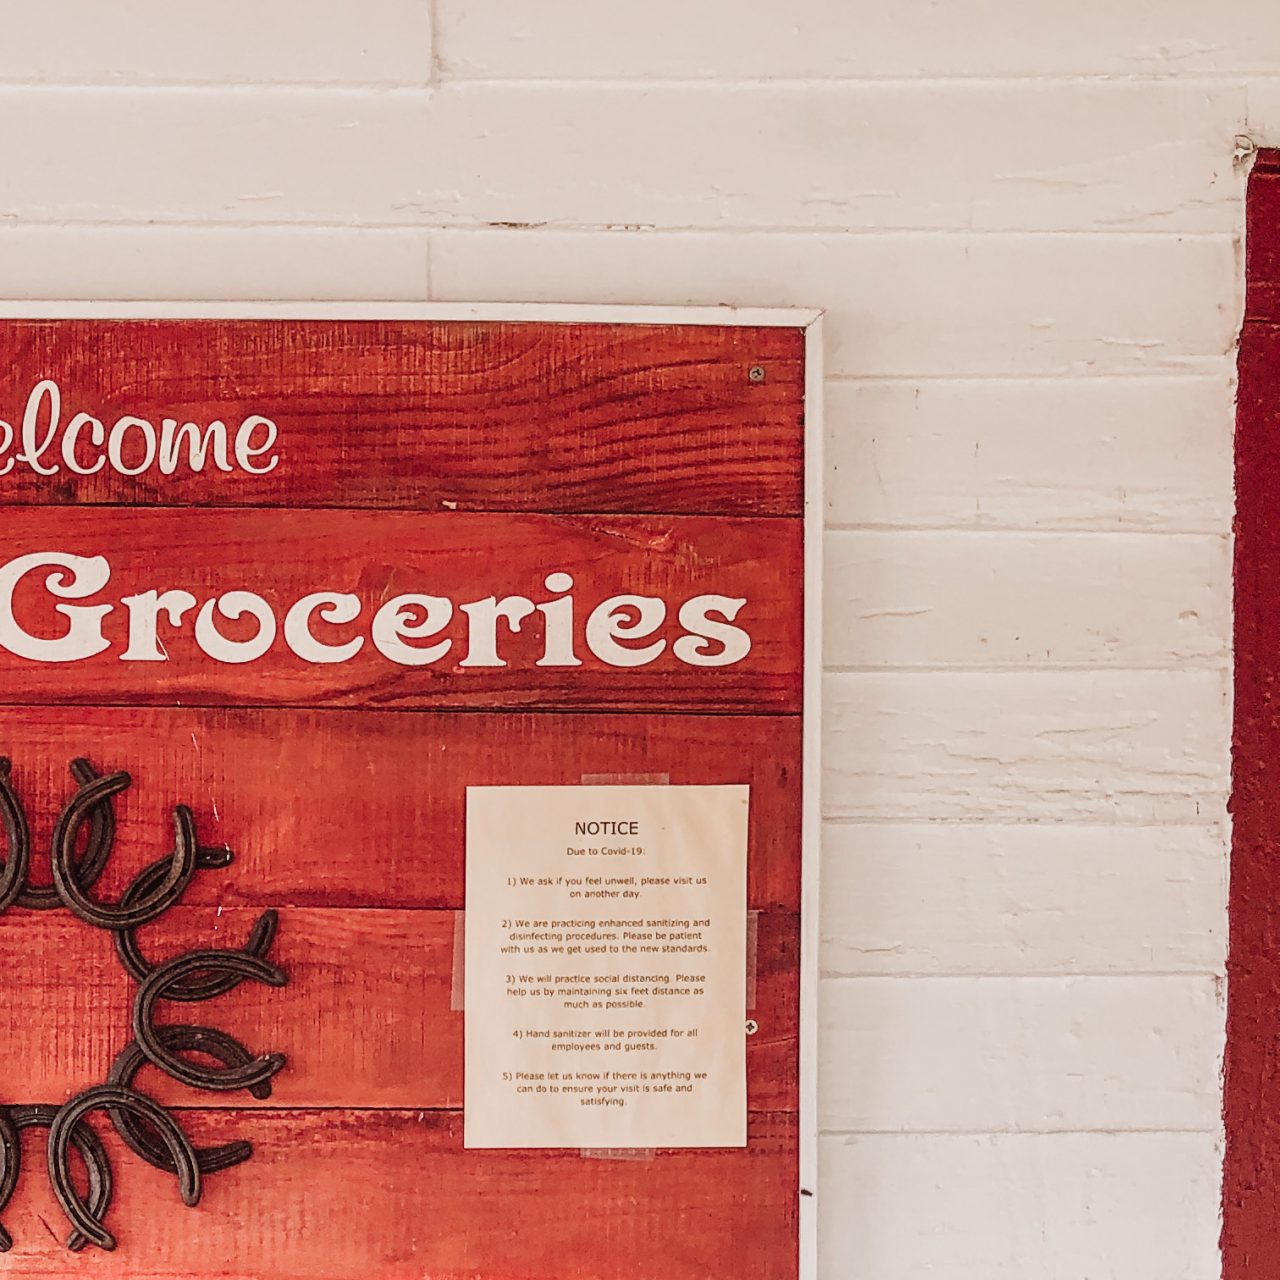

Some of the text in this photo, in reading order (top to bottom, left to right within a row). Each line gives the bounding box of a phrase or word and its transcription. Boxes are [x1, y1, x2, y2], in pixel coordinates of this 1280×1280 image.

[574, 820, 639, 836] NOTICE
[566, 846, 646, 856] Due to Covid-19:
[507, 876, 708, 888] 1) We ask if you feel unwell, please visit us
[569, 890, 582, 899] on
[584, 889, 621, 899] another
[501, 918, 711, 930] 2) We are practicing enhanced sanitizing and
[508, 931, 703, 943] disinfecting procedures. Please be patient
[500, 944, 521, 954] with
[523, 945, 535, 954] us
[537, 945, 549, 954] as
[550, 945, 565, 954] we
[566, 945, 582, 956] get
[584, 944, 607, 954] used
[608, 944, 620, 954] to
[621, 944, 638, 953] the
[639, 945, 660, 953] new
[505, 974, 516, 986] 3)
[518, 975, 535, 984] We
[536, 974, 552, 984] will
[554, 974, 591, 985] practice
[593, 974, 620, 984] social
[675, 973, 706, 983] Please
[506, 986, 705, 998] help us by maintaining six feet distance as
[563, 999, 590, 1009] much
[591, 1001, 604, 1009] as
[512, 1028, 698, 1040] 4) Hand sanitizer will be provided for all
[551, 1041, 658, 1053] employees and guests.
[502, 1071, 708, 1082] 5) Please let us know if there is anything we
[516, 1083, 693, 1095] can do to ensure your visit is safe and
